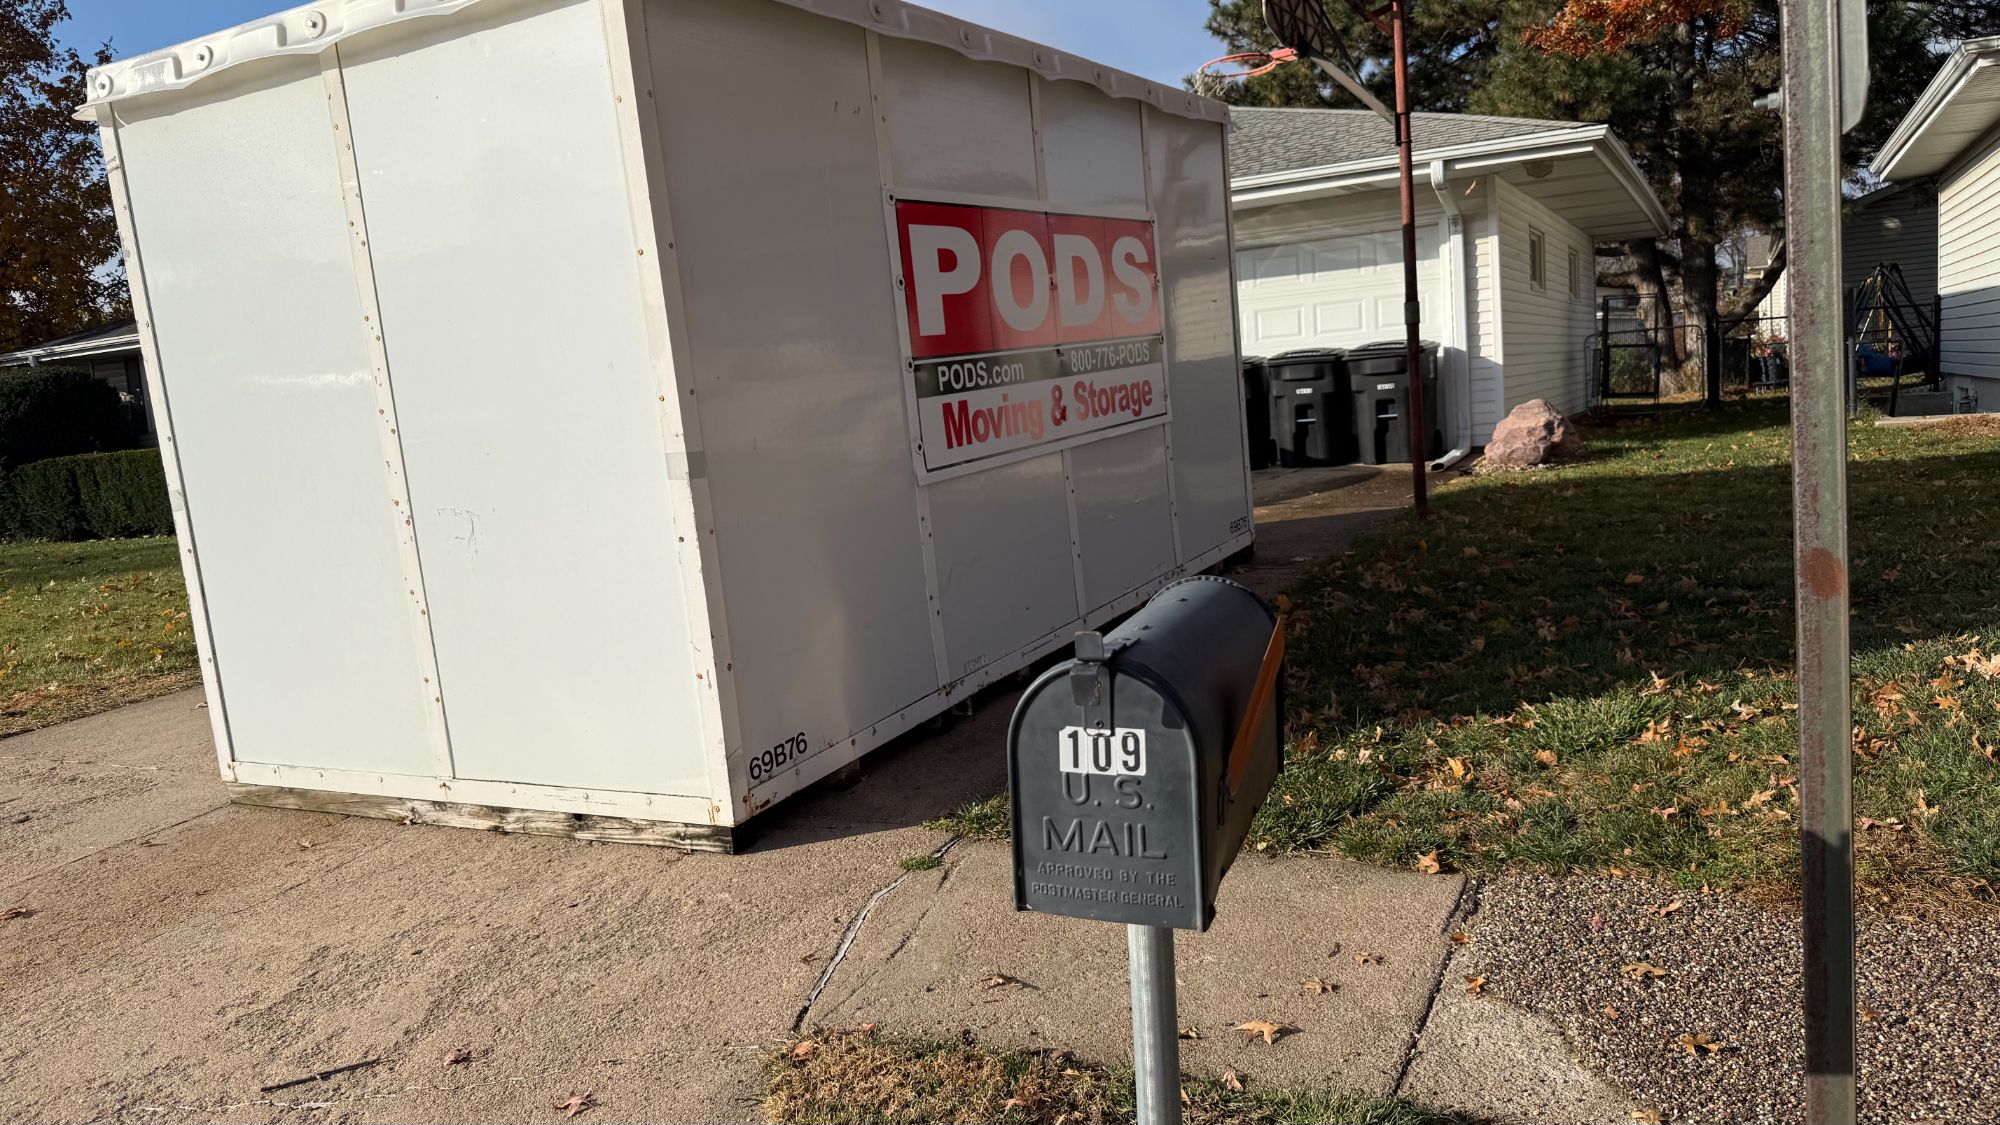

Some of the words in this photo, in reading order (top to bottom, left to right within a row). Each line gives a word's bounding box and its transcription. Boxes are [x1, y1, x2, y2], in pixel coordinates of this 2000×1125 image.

[908, 223, 1153, 337] PODS
[937, 361, 1025, 392] PODS.com
[1071, 342, 1150, 372] 800-776-PODS
[942, 393, 1045, 450] Moving
[1051, 384, 1067, 427] &
[1073, 379, 1153, 421] Storage
[749, 731, 808, 780] 69B76
[1067, 729, 1141, 772] 109
[1043, 815, 1168, 860] MAIL
[1031, 881, 1119, 904] POSTMASTER
[1120, 892, 1184, 909] GENERAL
[1038, 861, 1113, 882] APPROVED
[1120, 869, 1138, 883] BY
[1147, 871, 1177, 887] THE
